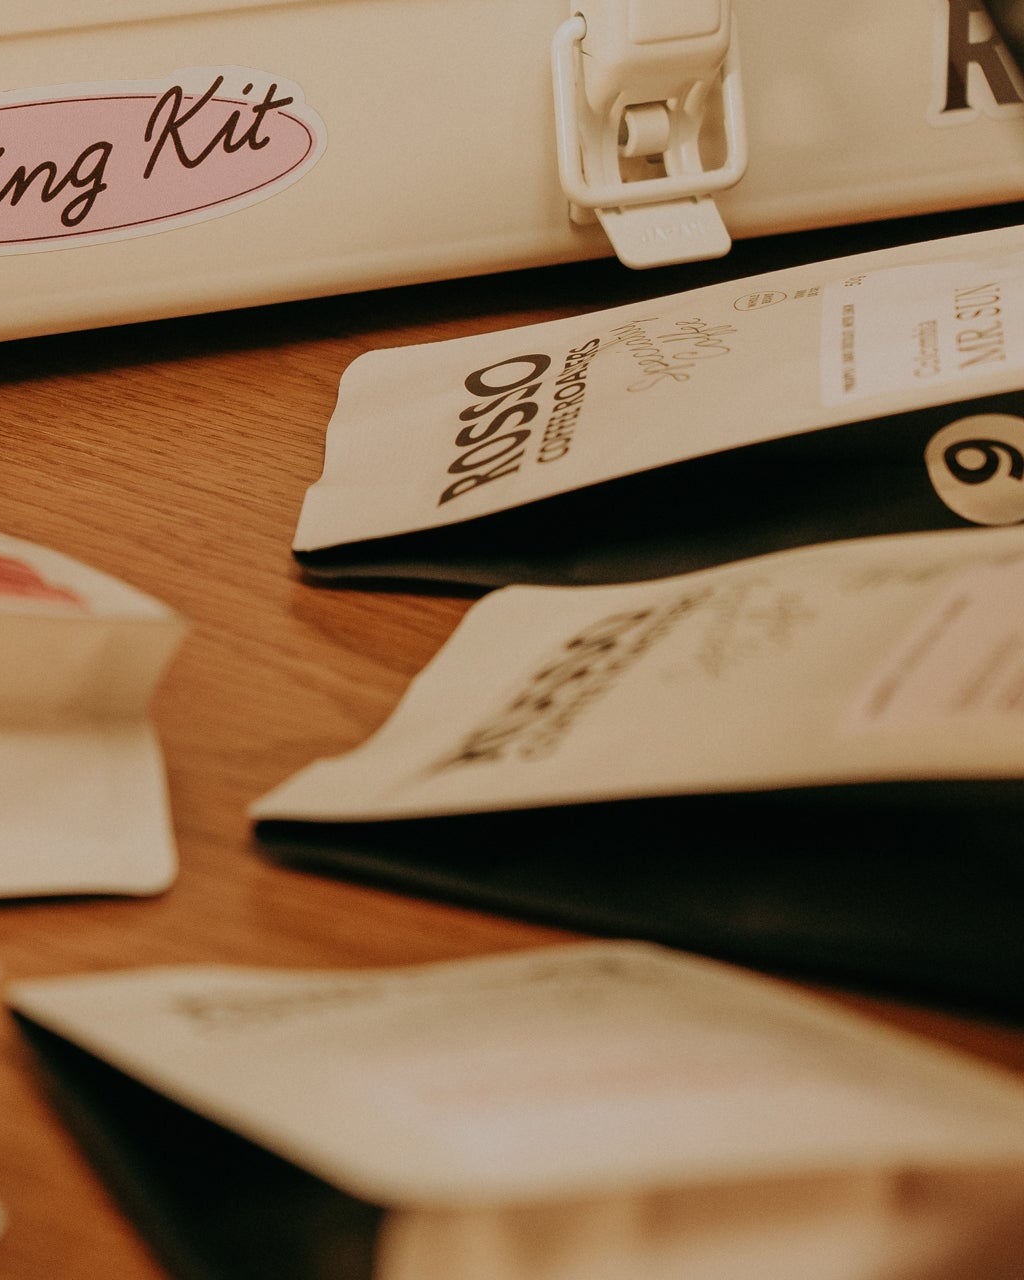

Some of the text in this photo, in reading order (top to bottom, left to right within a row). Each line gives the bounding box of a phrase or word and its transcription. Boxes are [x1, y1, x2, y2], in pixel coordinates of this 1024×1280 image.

[144, 75, 294, 180] Kit
[954, 281, 1002, 320] SUN
[437, 353, 551, 508] ROSSO
[536, 407, 583, 465] COFFEE
[943, 439, 1024, 485] 9
